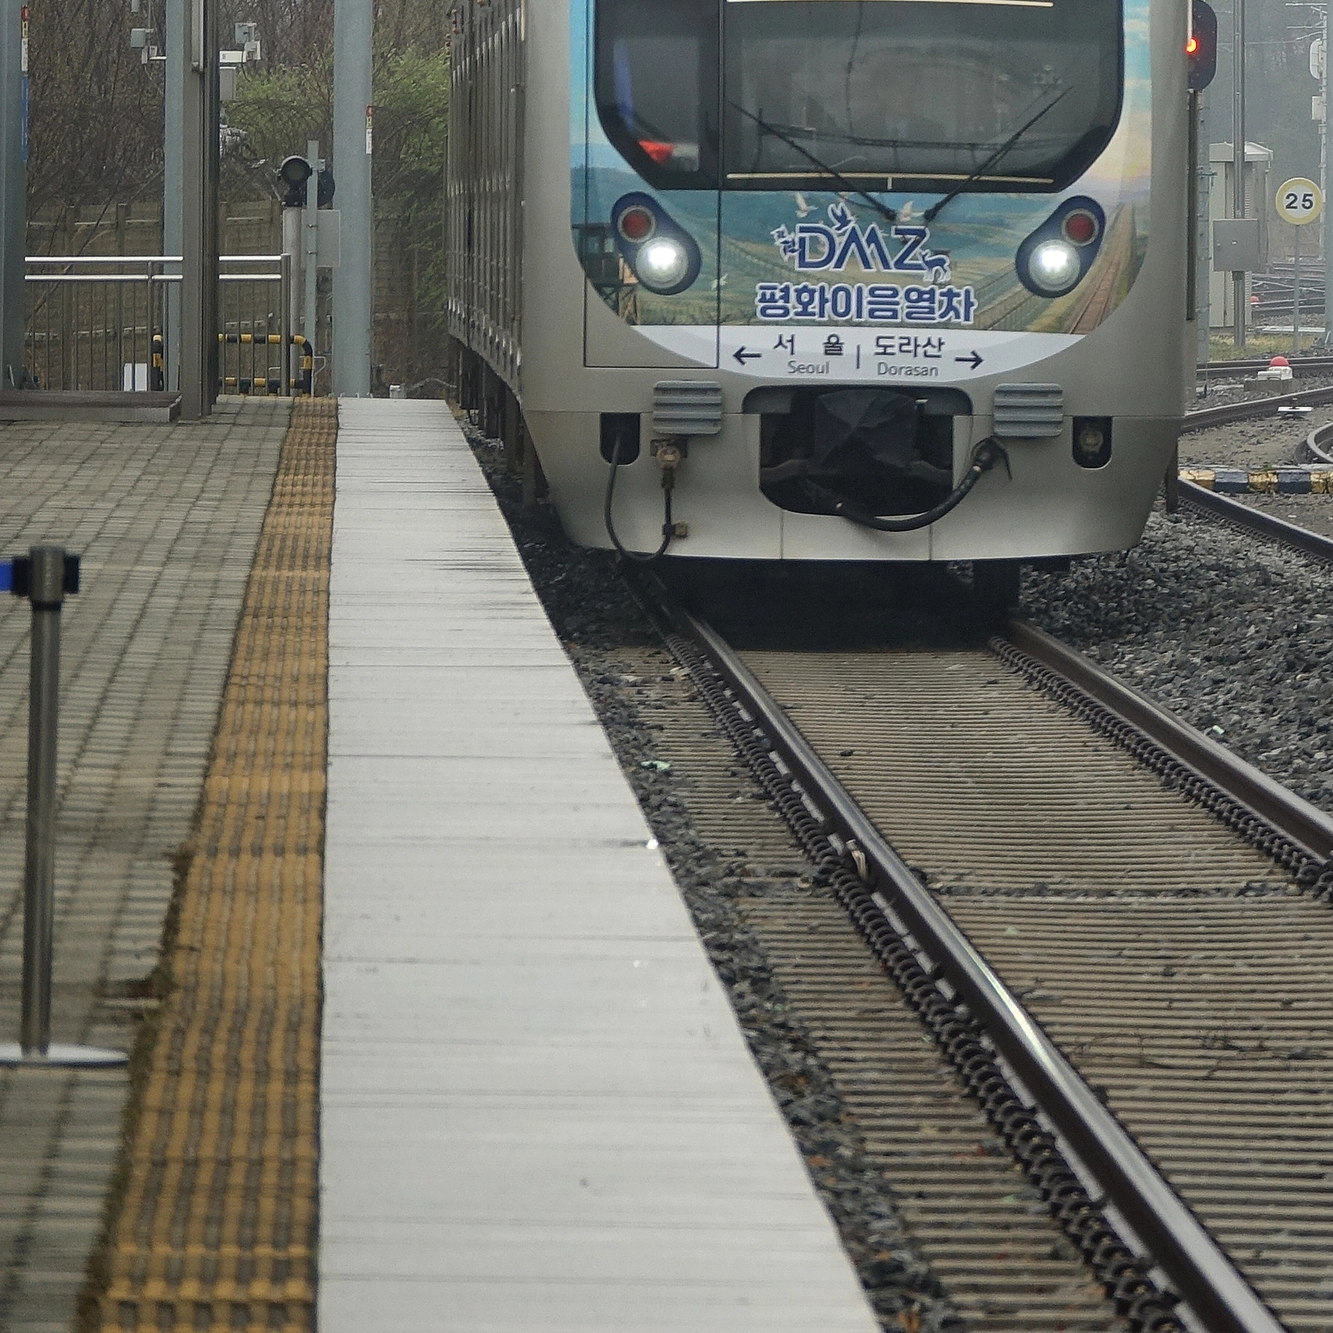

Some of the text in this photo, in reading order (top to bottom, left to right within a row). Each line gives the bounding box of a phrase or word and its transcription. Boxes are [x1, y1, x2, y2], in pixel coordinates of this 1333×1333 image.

[1285, 193, 1314, 210] 25
[796, 223, 929, 271] DMZ
[756, 283, 977, 323] 평화이음열차
[874, 335, 945, 359] 도라산
[787, 360, 939, 377] Seoul Dorasan
